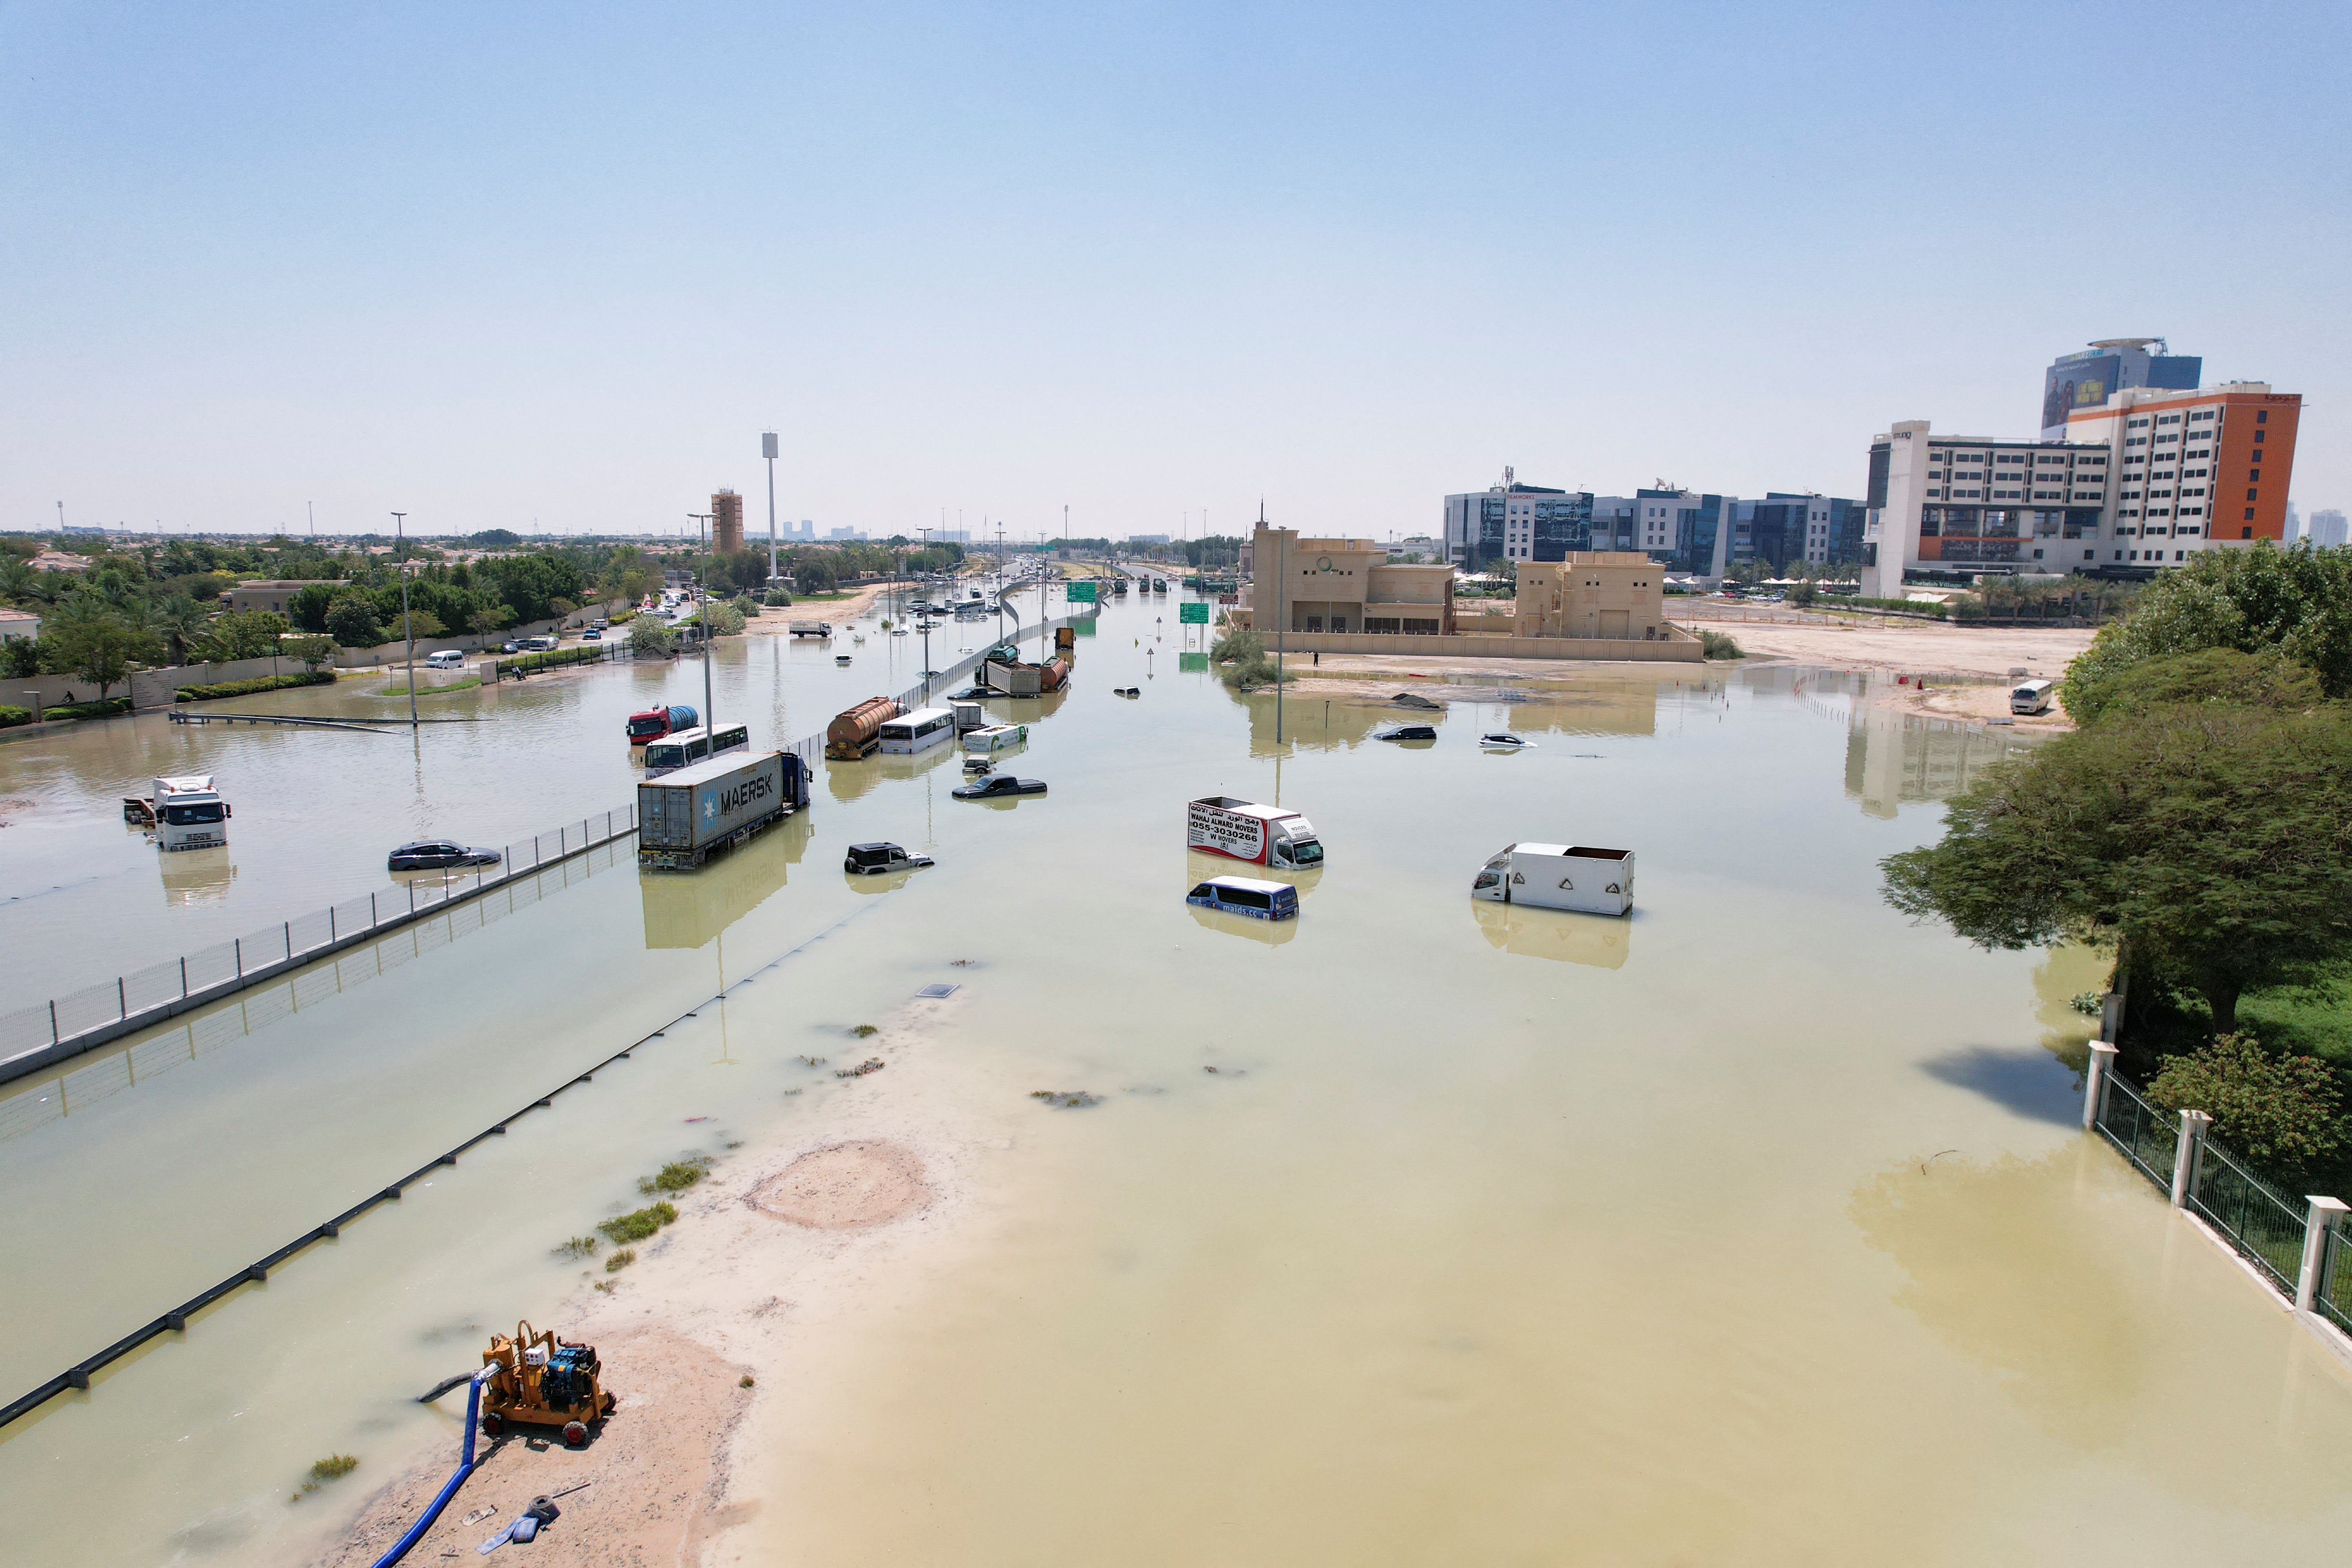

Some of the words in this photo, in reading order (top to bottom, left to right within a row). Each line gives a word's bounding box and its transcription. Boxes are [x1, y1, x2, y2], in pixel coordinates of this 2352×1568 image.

[721, 773, 772, 815] MAERSK
[1191, 813, 1210, 823] WAHAJ
[1211, 818, 1233, 828] ALWARD
[1235, 823, 1258, 834] MOVERS
[1192, 821, 1258, 842] 055-3030266
[1218, 835, 1237, 844] MOVERS
[1223, 905, 1257, 917] maids.cc
